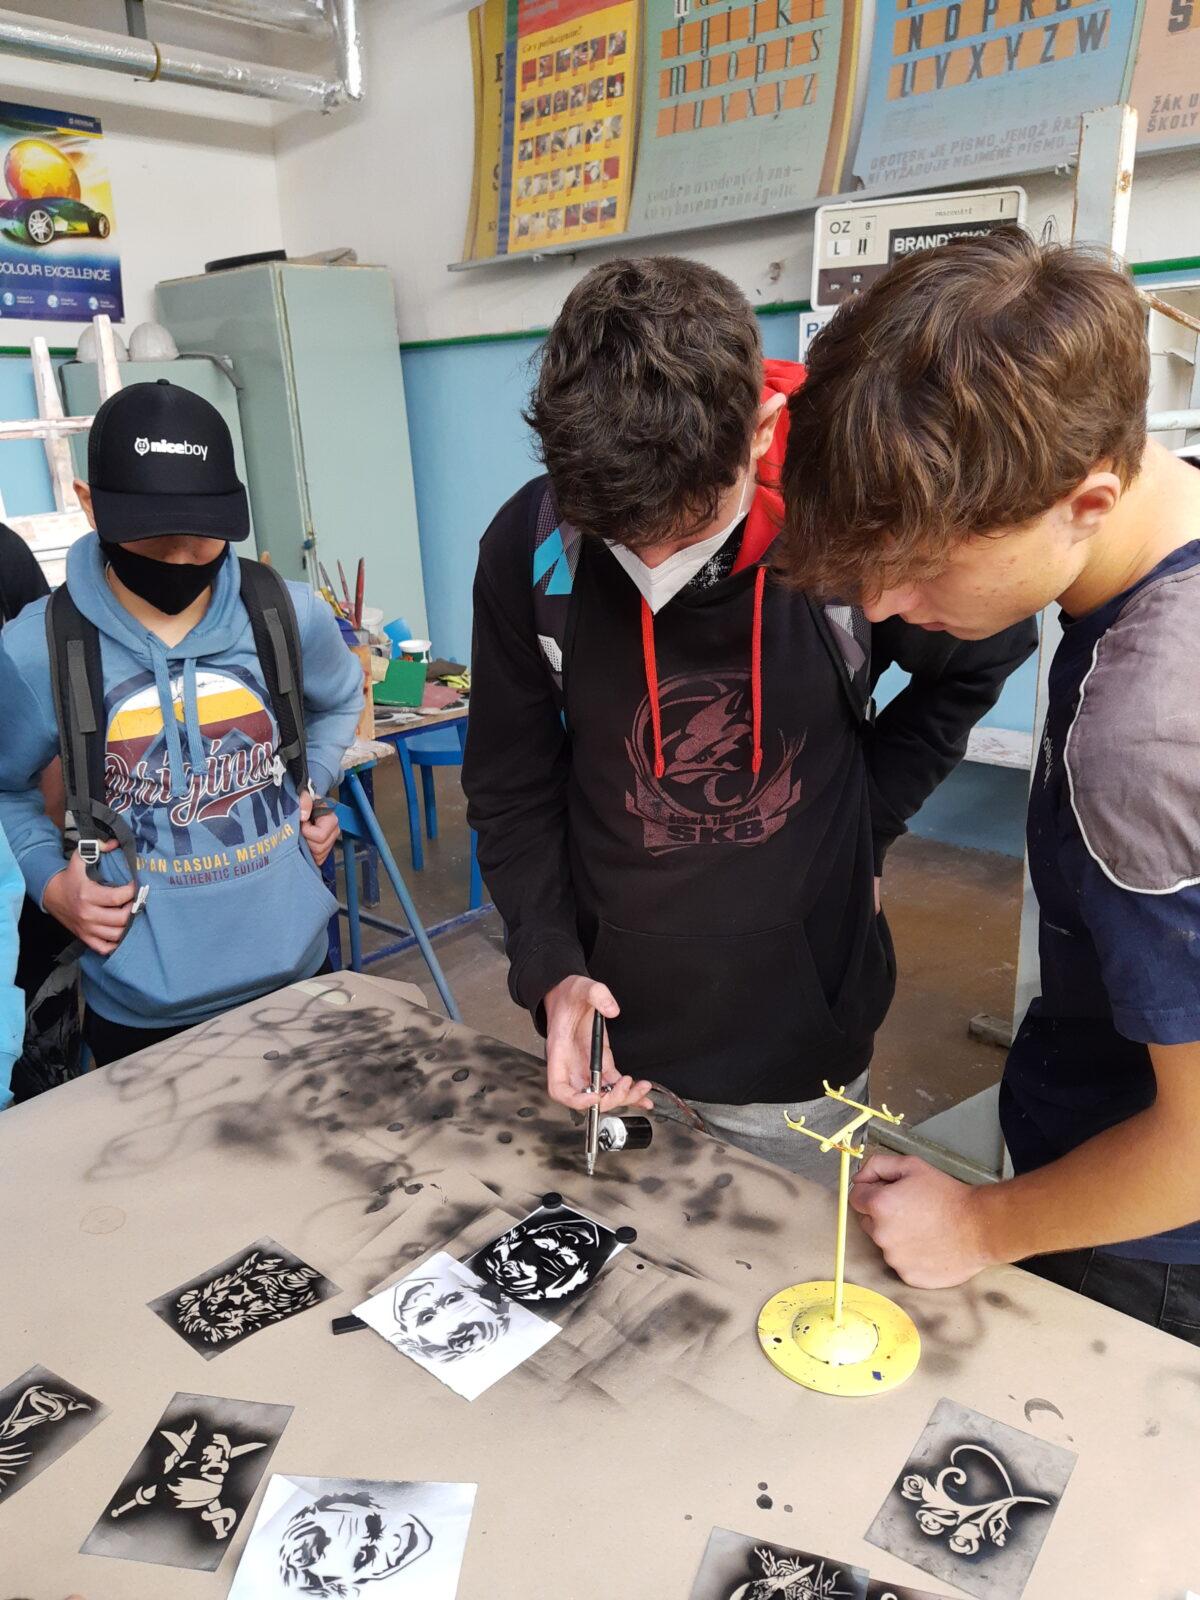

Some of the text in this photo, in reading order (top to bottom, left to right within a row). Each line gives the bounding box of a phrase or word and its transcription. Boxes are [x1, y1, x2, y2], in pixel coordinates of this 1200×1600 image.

[830, 220, 851, 234] OZ
[44, 266, 111, 281] EXCELLENCE
[150, 439, 208, 461] niceboy
[173, 853, 230, 873] CASUAL
[169, 869, 230, 886] AUTHENTIC
